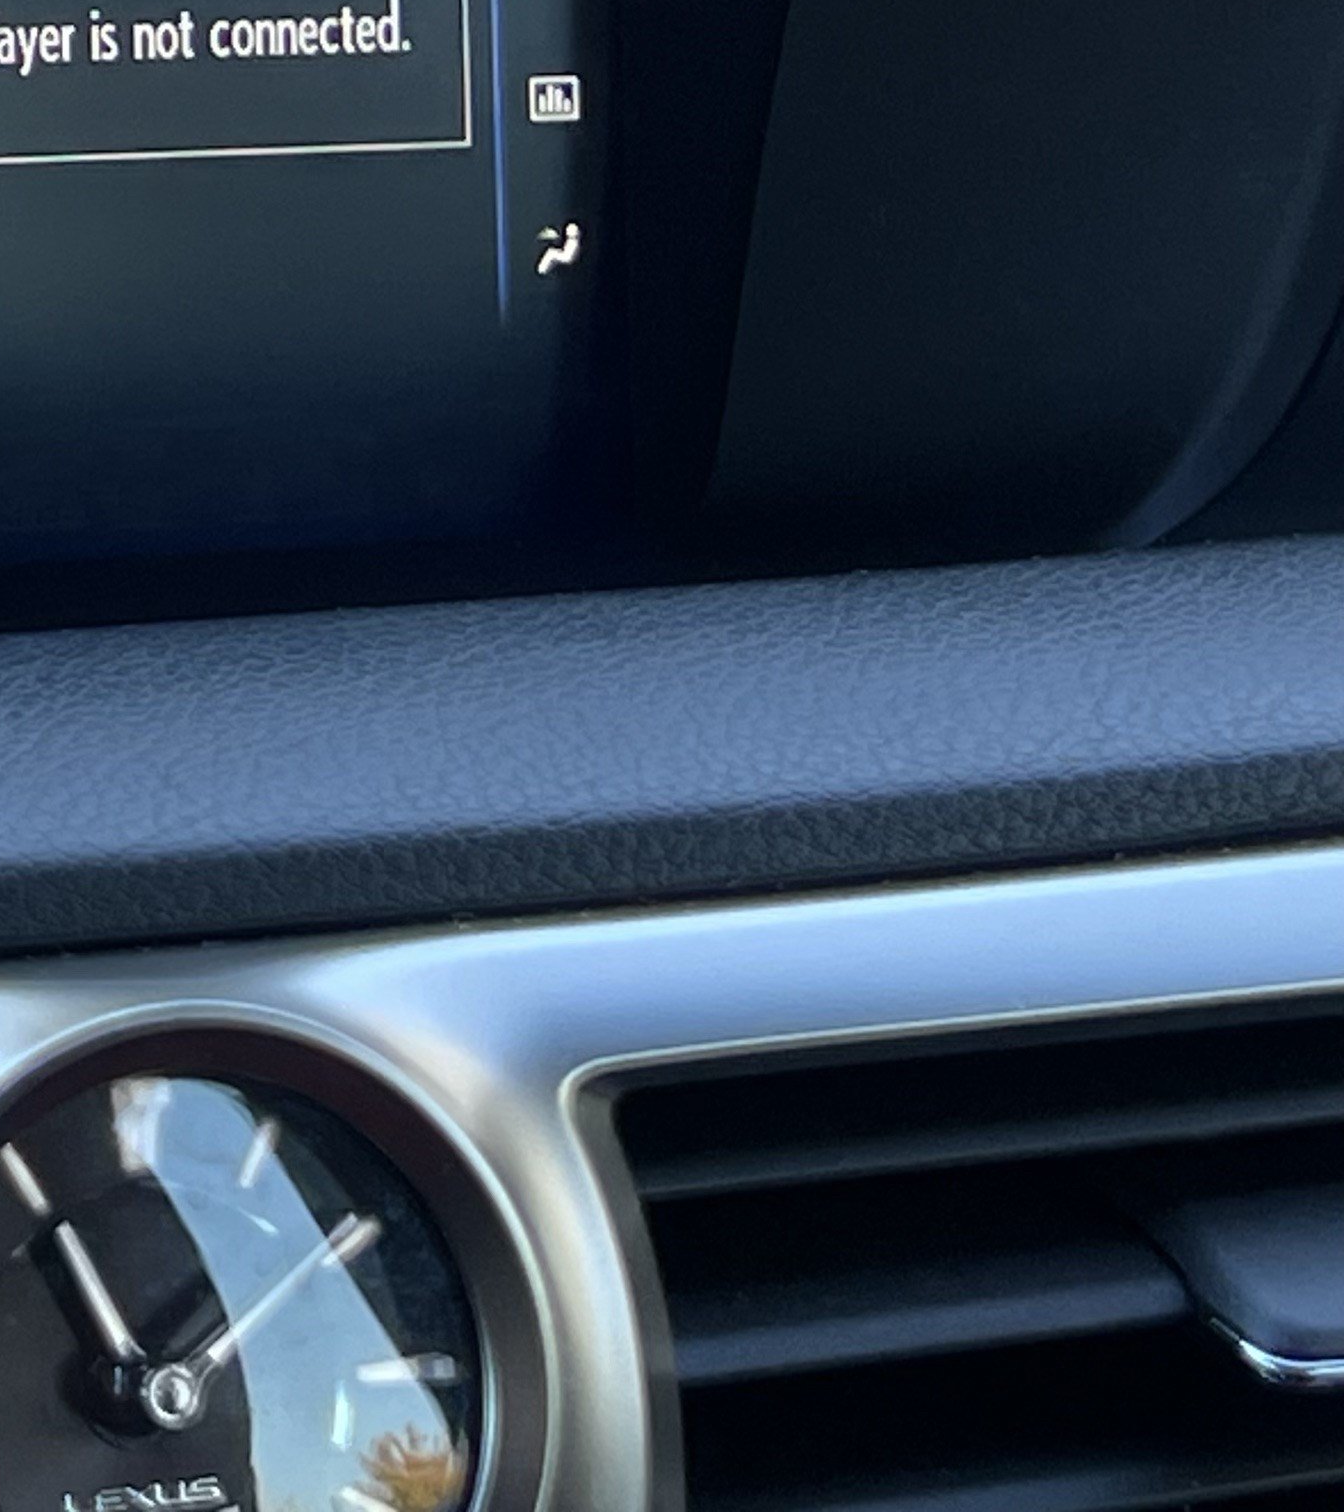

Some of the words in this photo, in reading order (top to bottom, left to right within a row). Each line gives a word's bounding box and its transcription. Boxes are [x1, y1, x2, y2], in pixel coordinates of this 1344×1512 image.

[89, 9, 119, 61] is
[132, 10, 195, 60] not
[63, 1475, 222, 1512] LEXUS
